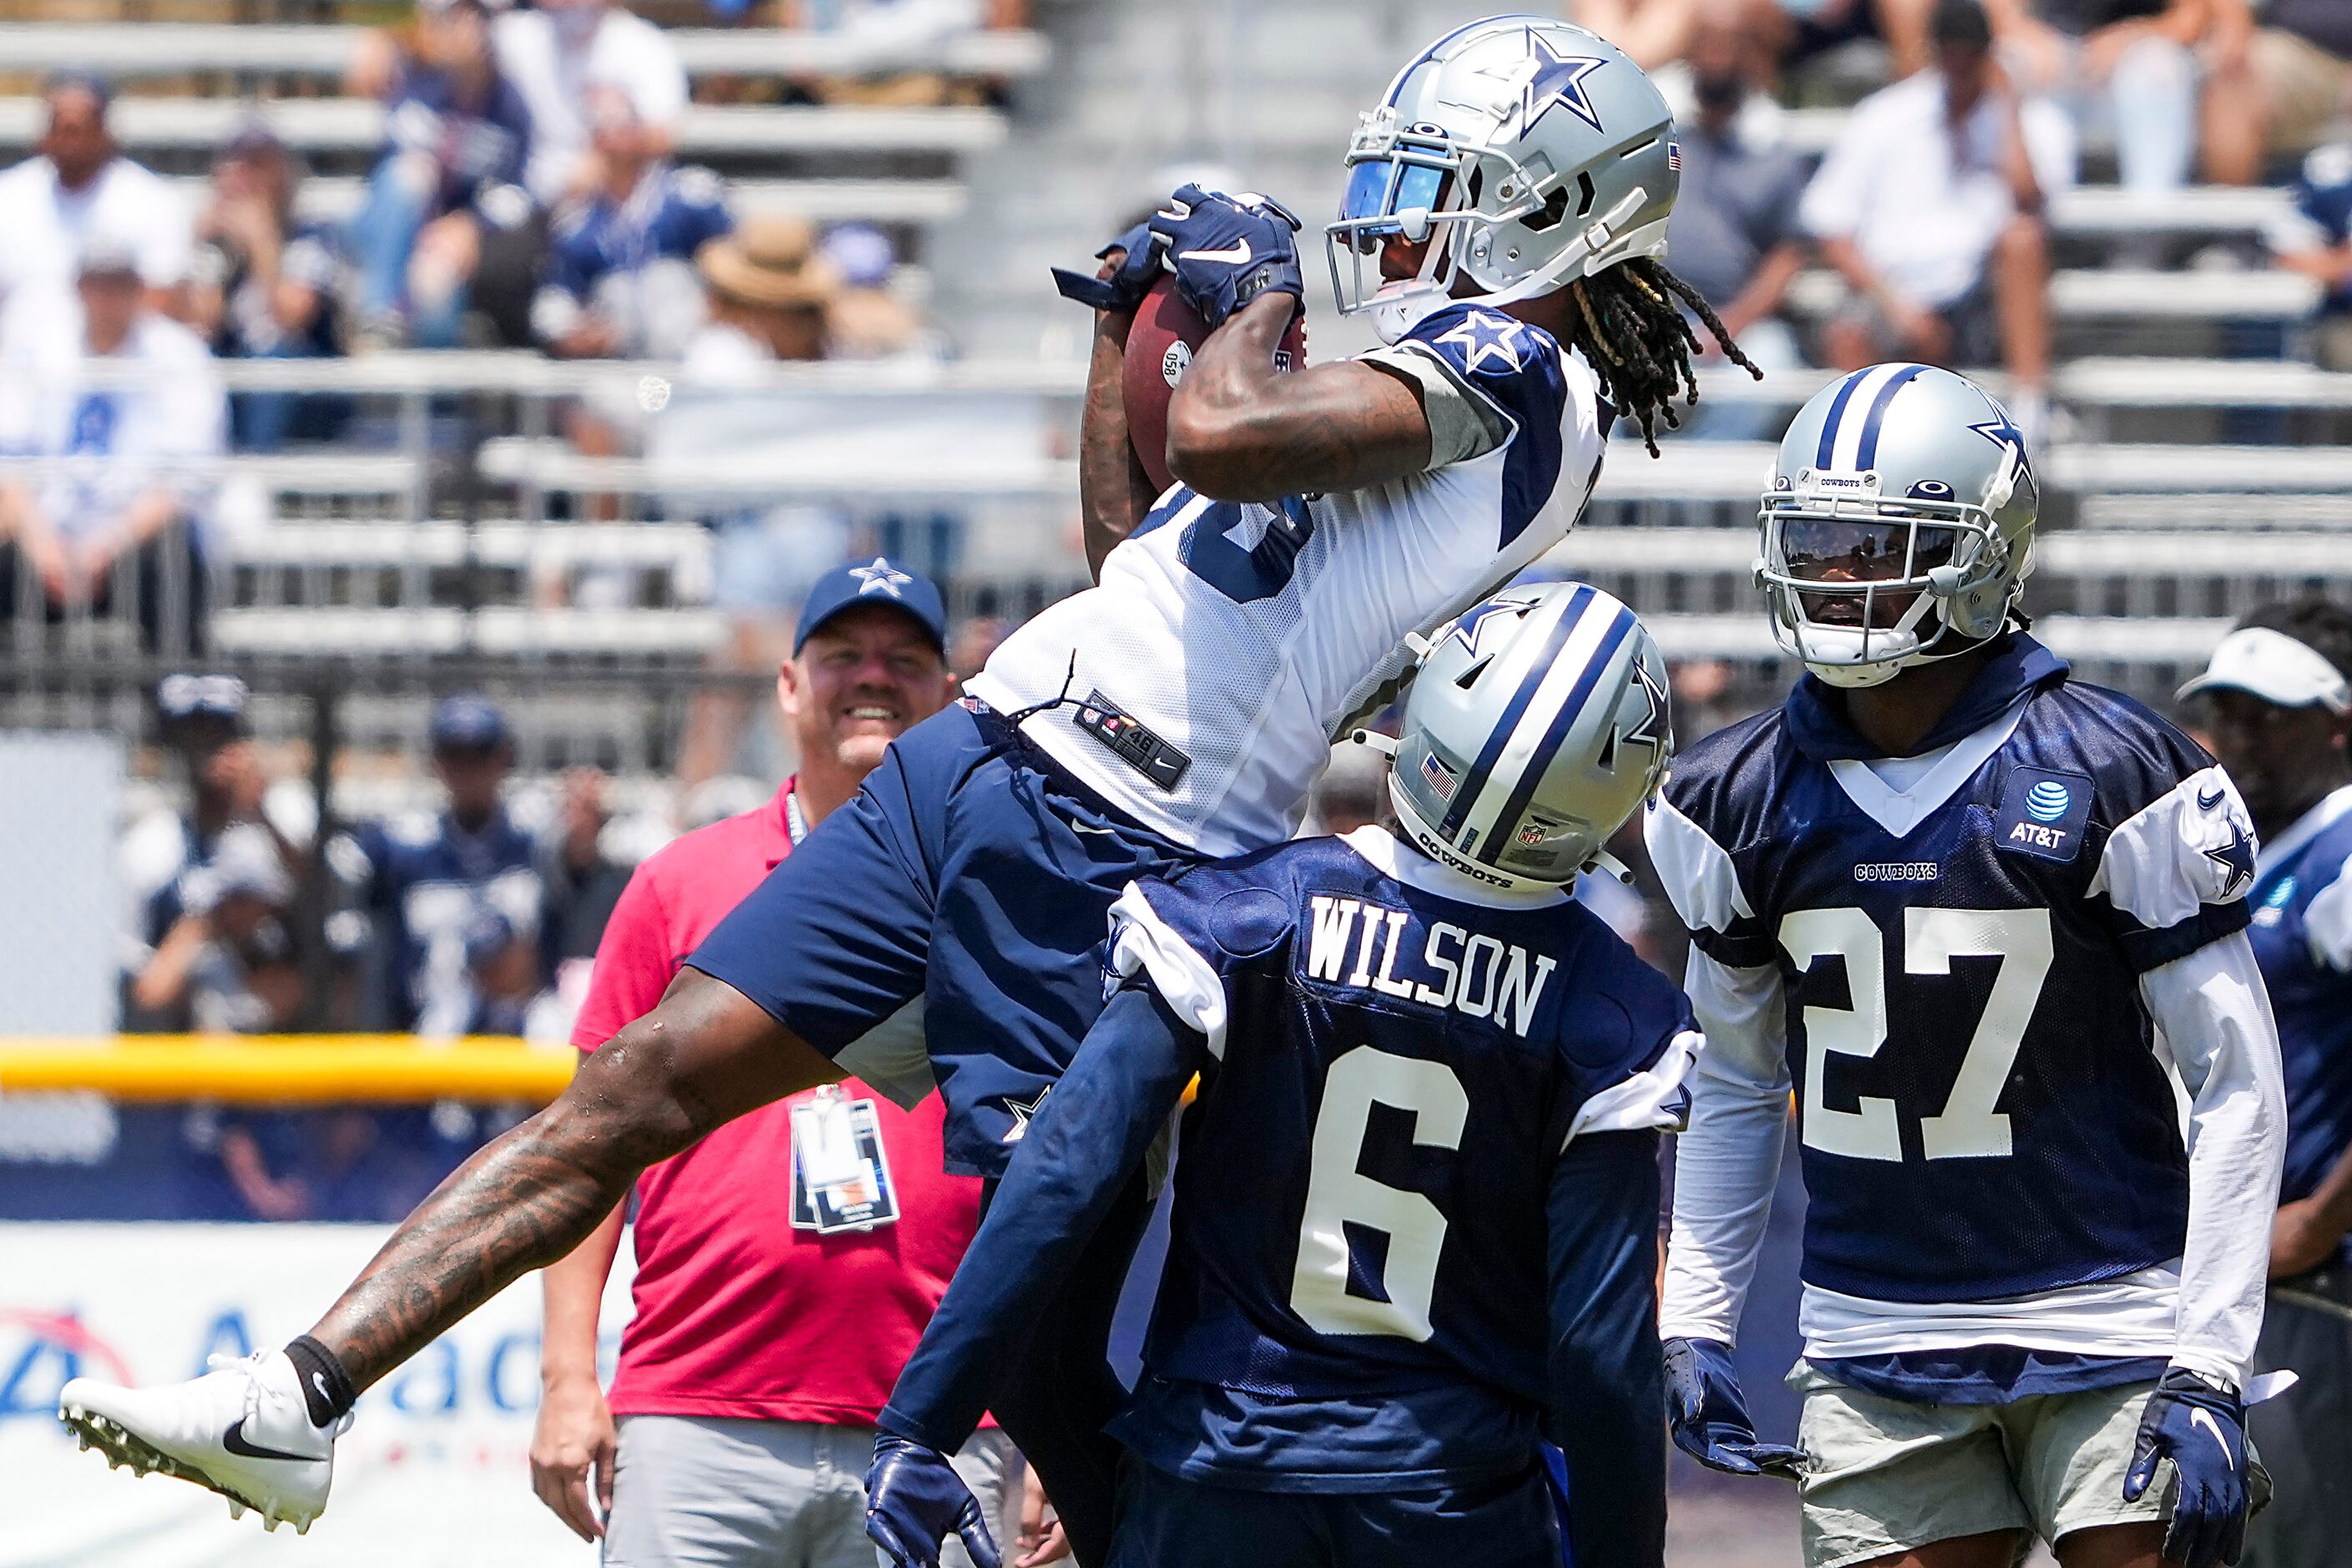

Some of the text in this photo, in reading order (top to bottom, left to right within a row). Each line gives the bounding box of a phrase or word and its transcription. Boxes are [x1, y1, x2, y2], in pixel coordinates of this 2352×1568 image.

[1164, 352, 1178, 376] 058
[1821, 478, 1860, 488] COWBOYS
[1521, 832, 1540, 845] NFL
[2010, 822, 2066, 849] AT&T
[1419, 832, 1514, 889] COWBOYS
[1854, 862, 1938, 882] COWBOYS
[1308, 895, 1557, 1039] WILSON
[1778, 907, 2054, 1163] 27
[1289, 1044, 1469, 1343] 6
